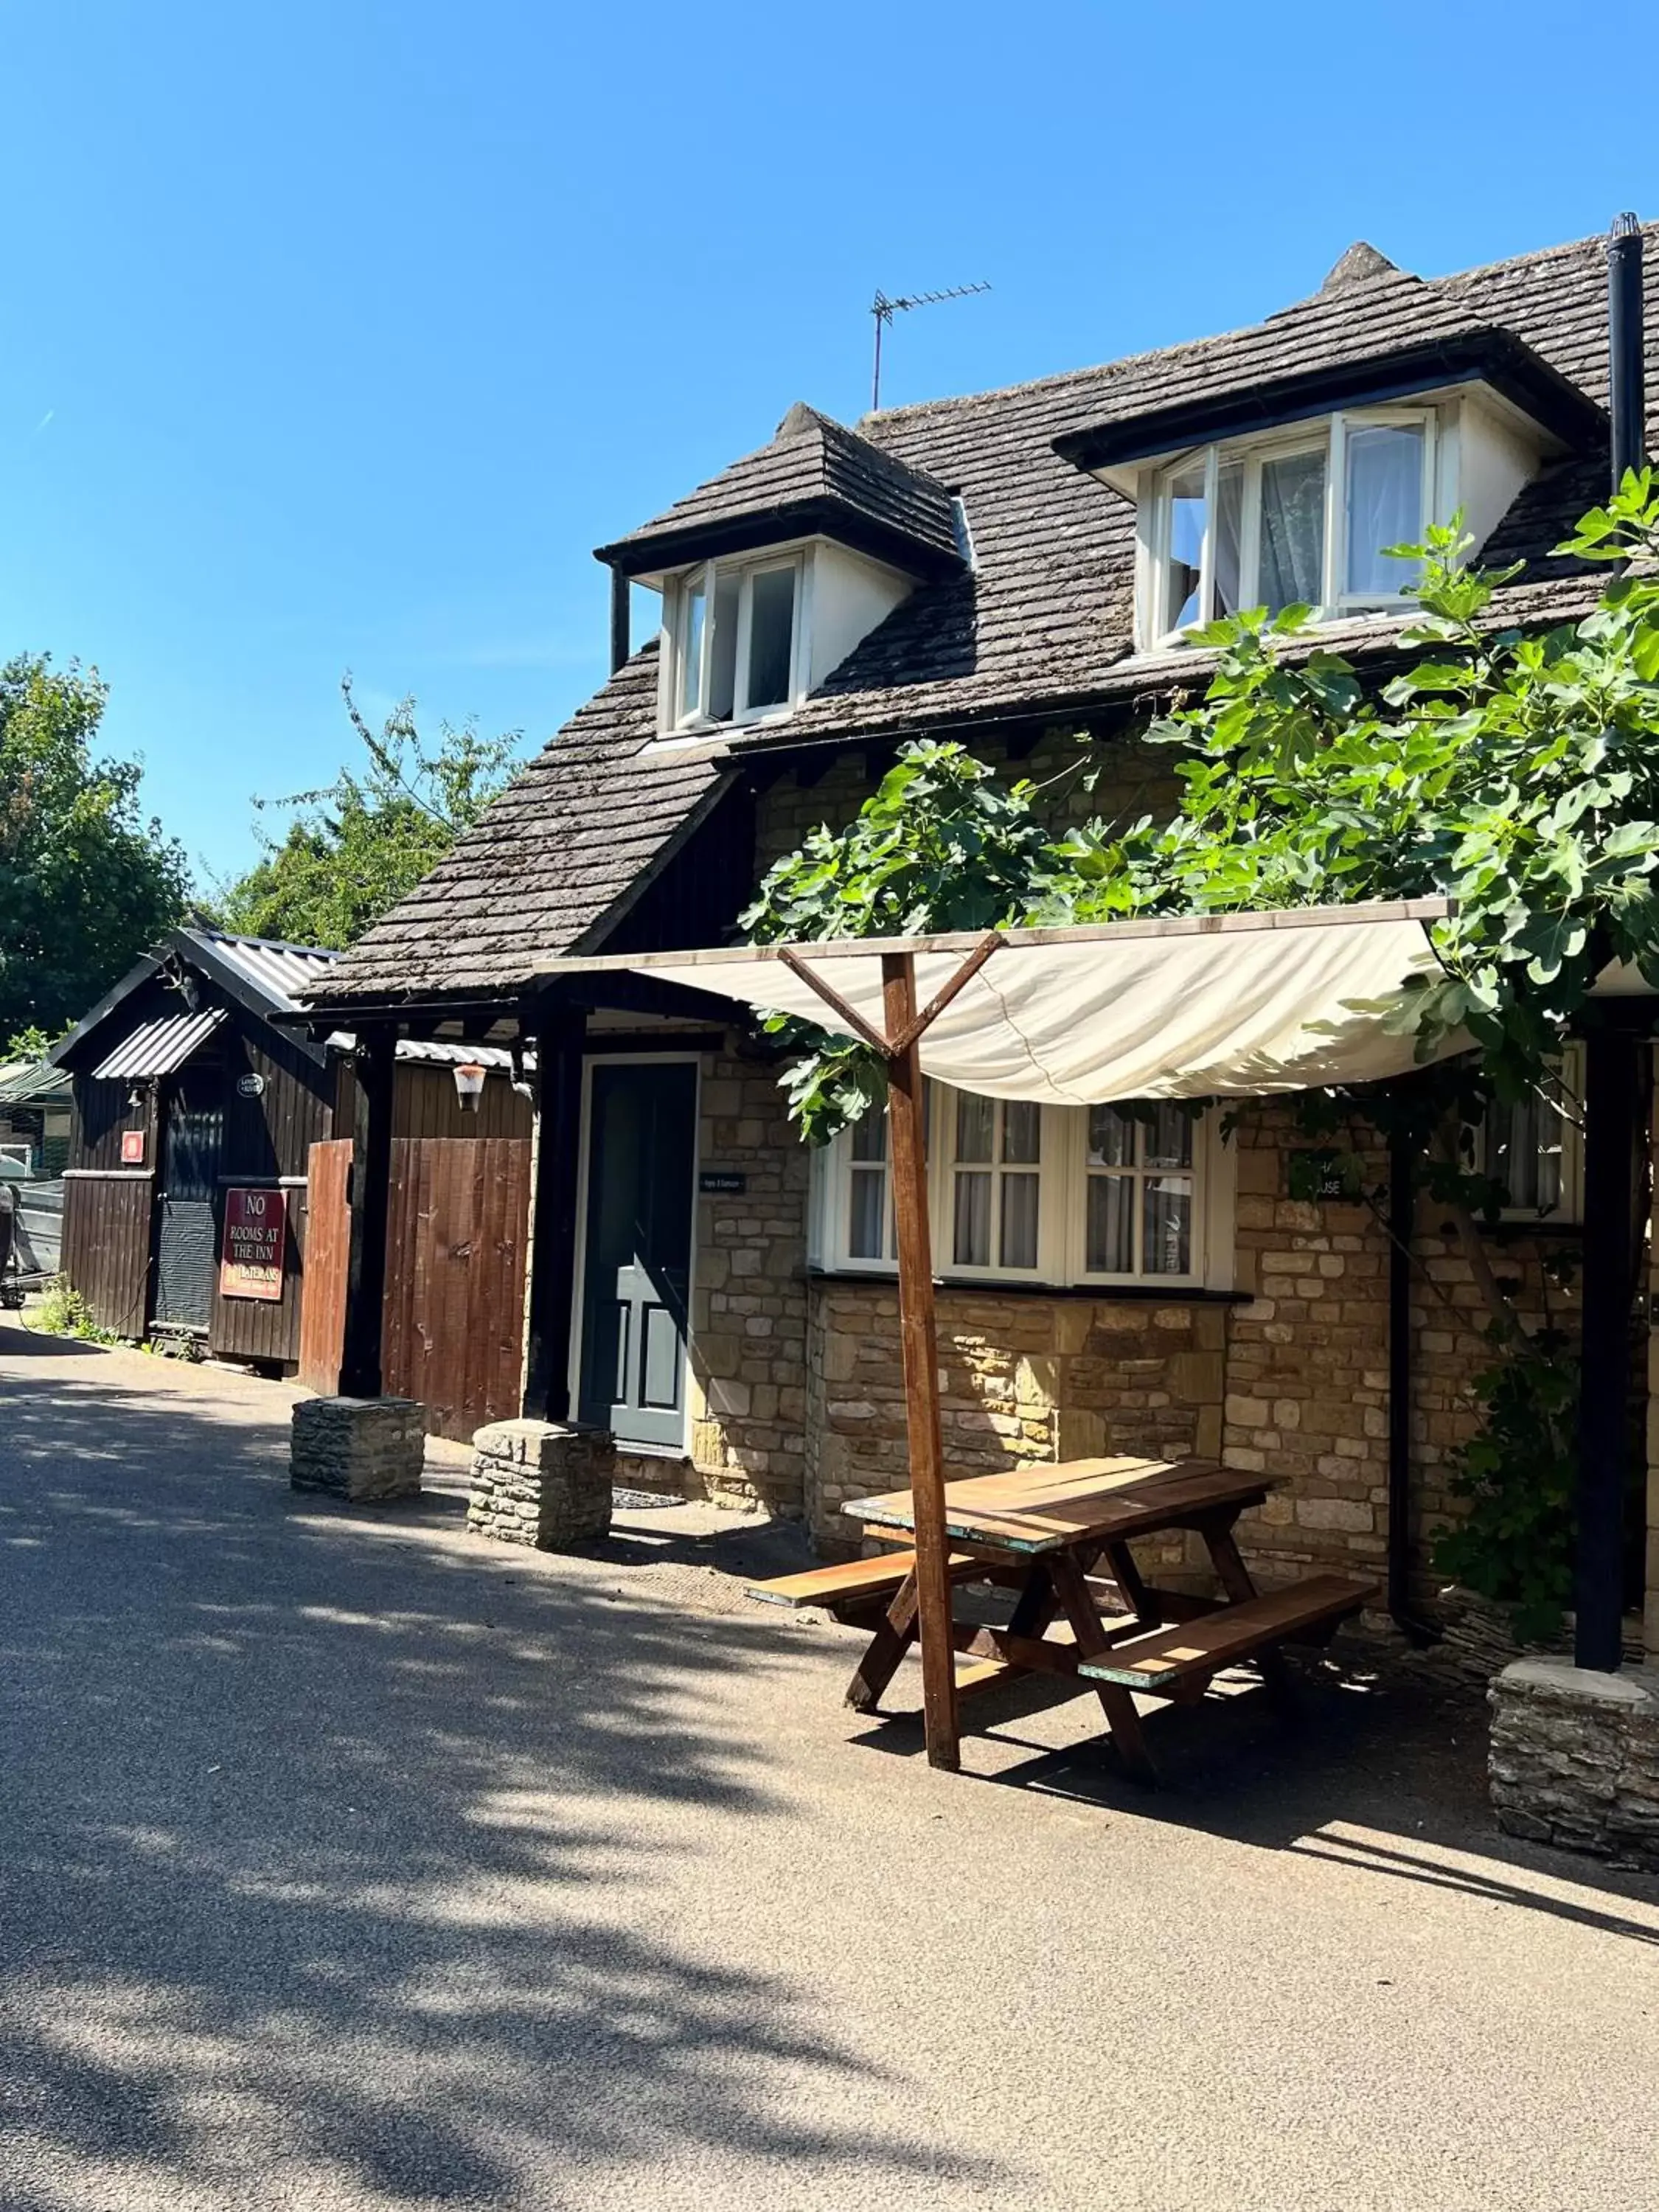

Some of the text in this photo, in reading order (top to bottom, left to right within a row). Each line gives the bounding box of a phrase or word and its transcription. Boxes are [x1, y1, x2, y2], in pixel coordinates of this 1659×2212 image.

[246, 1195, 265, 1215] NO
[230, 1226, 279, 1243] ROOMS AT
[234, 1244, 274, 1260] THE INN
